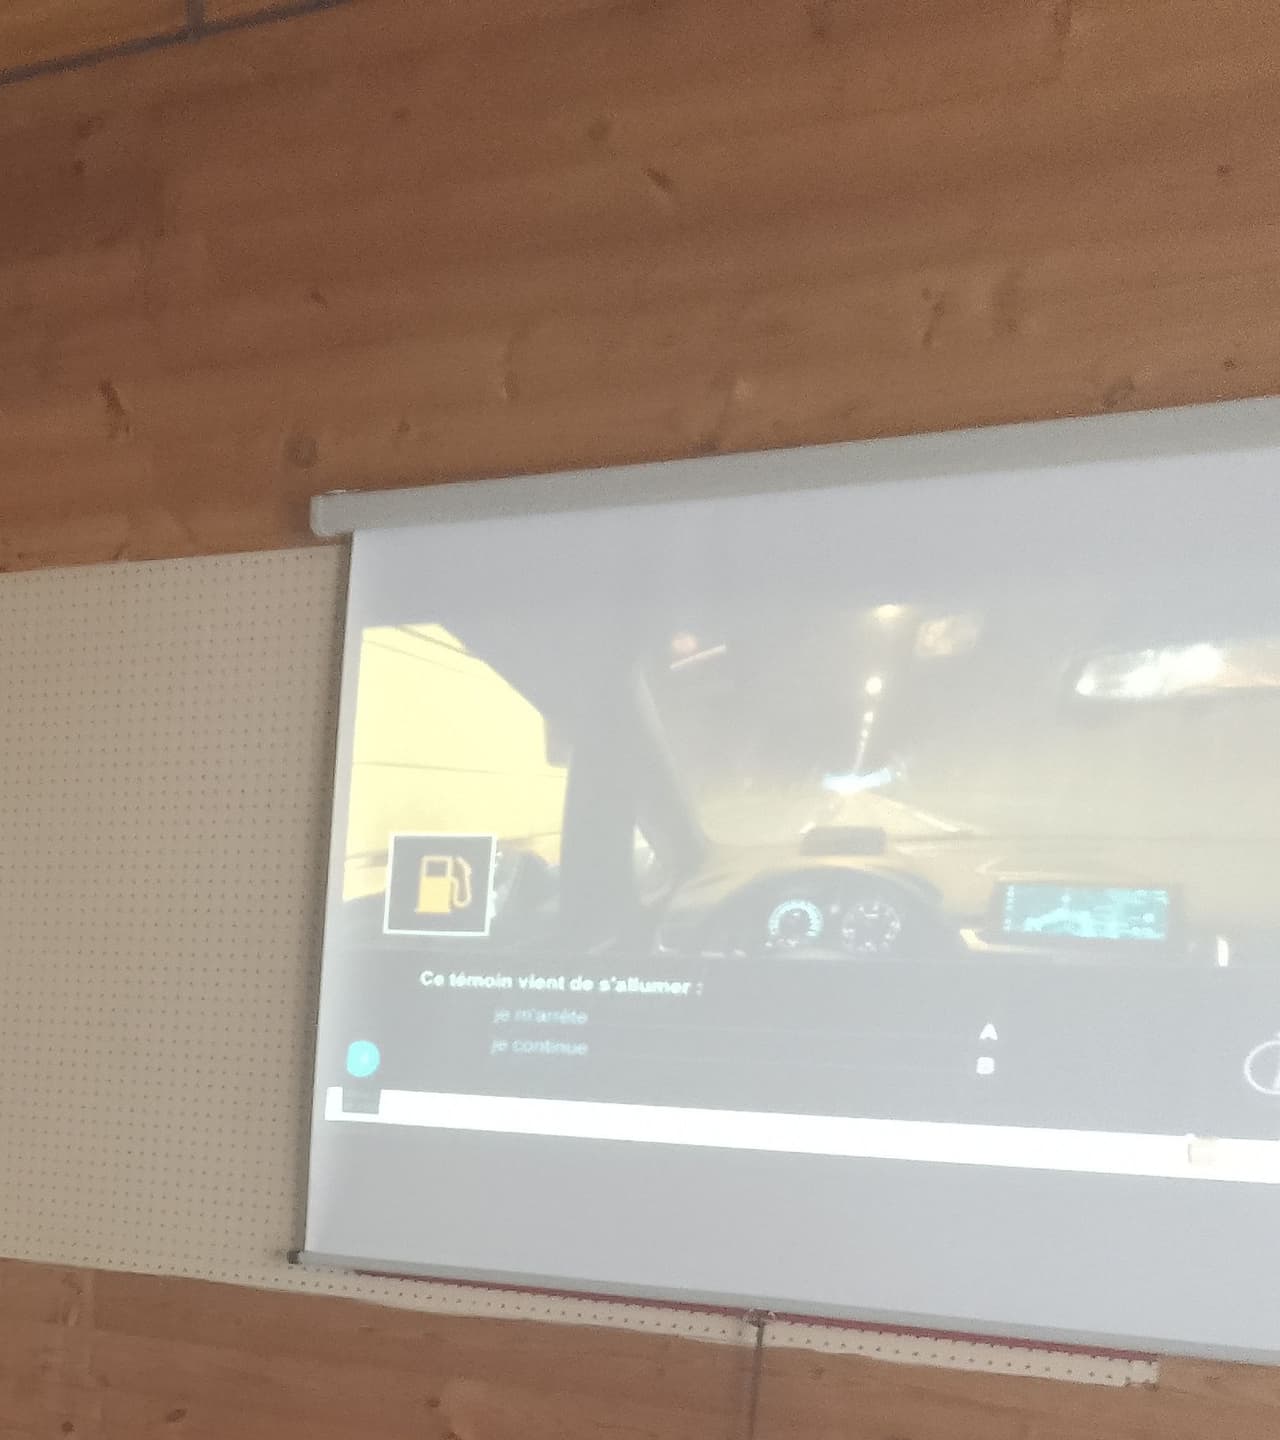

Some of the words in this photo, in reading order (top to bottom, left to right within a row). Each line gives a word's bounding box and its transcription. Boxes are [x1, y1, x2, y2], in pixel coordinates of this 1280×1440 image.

[419, 970, 445, 986] Ce
[449, 970, 513, 988] témoin
[518, 973, 565, 991] vient
[570, 975, 594, 992] de
[512, 1039, 589, 1055] continue
